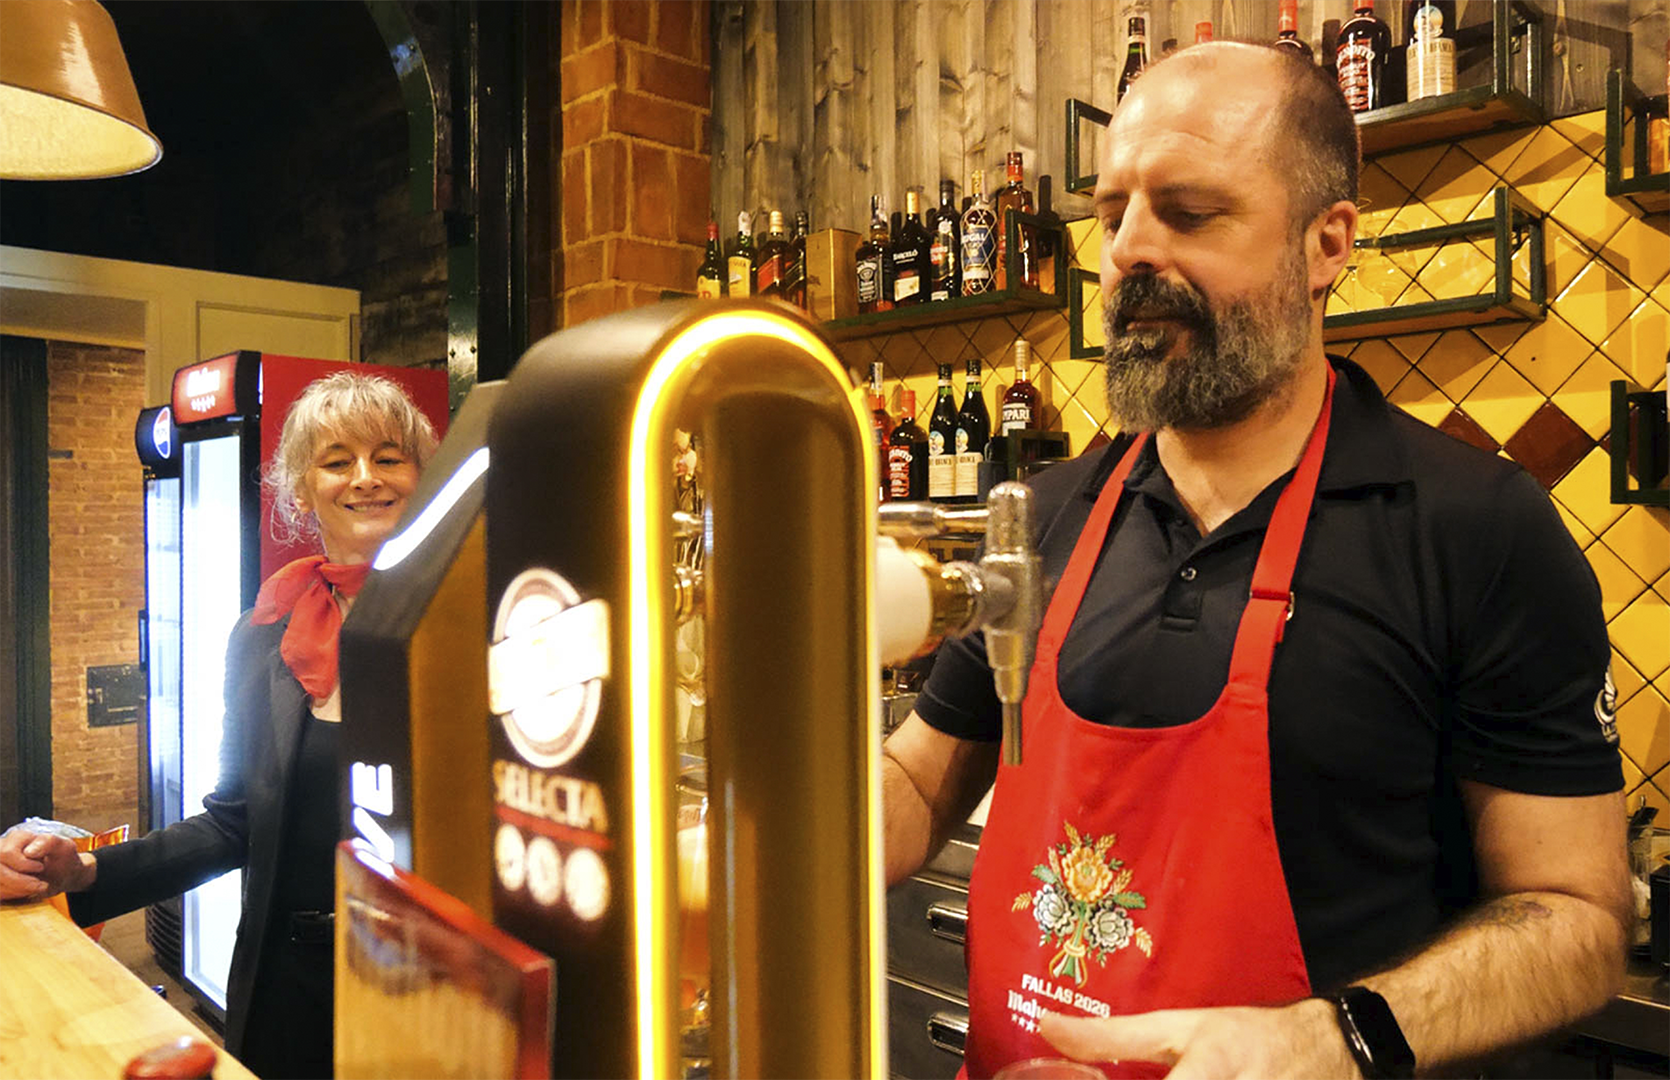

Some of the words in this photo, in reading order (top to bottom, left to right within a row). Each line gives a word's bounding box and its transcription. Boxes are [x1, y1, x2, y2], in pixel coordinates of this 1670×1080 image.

[493, 759, 609, 834] SELECTA
[1021, 973, 1073, 1004] FALLAS
[1007, 989, 1061, 1020] Mah
